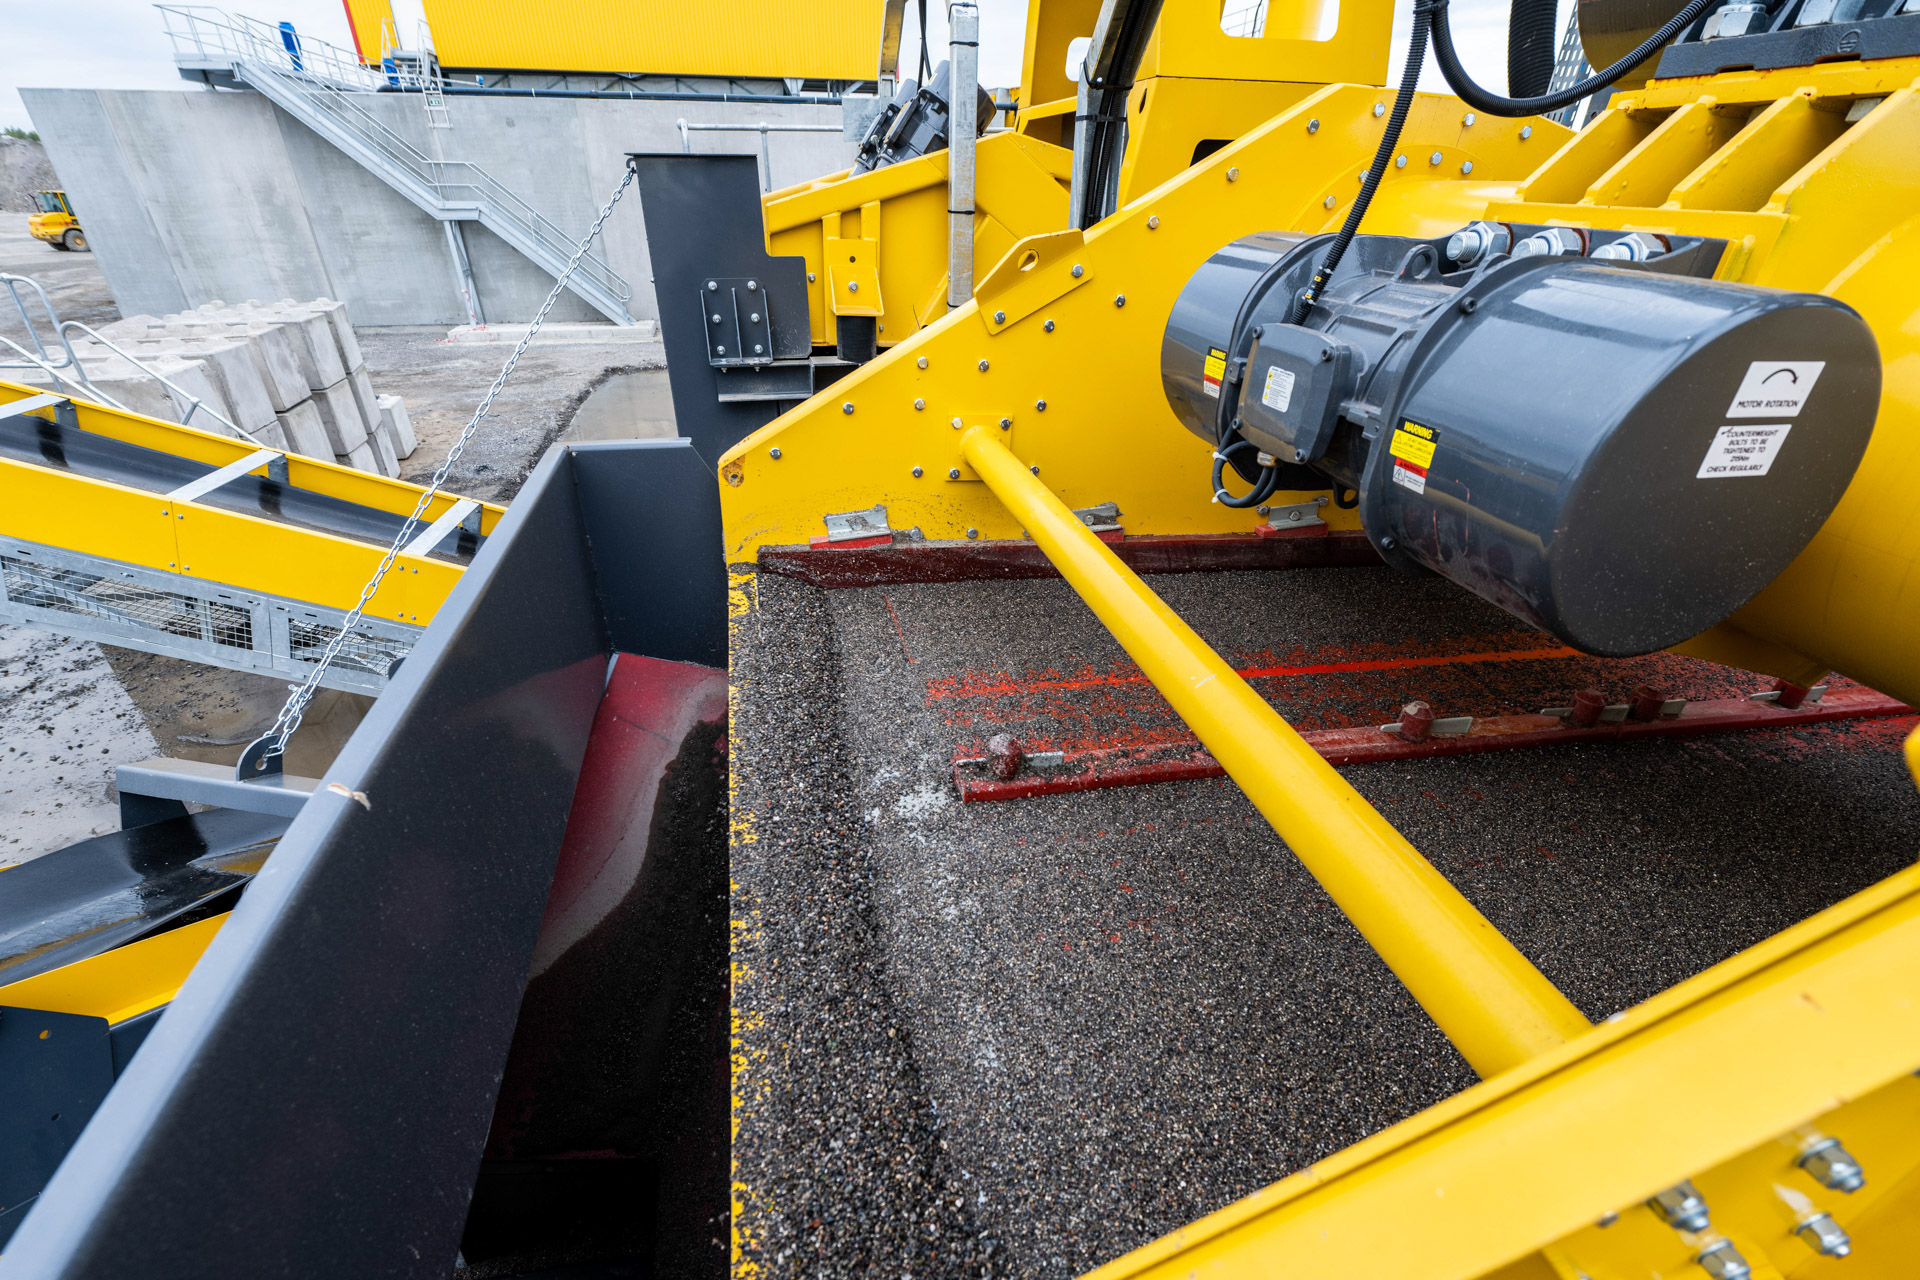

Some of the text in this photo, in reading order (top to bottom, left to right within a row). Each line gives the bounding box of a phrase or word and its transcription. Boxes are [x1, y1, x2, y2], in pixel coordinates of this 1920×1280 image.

[1737, 400, 1799, 408] MOTOR ROTATION
[1404, 421, 1432, 439] WARNING
[1727, 430, 1779, 438] COUNTERWEIGHT
[1723, 447, 1756, 455] TIGHTENED
[1728, 464, 1763, 472] REGULARLY
